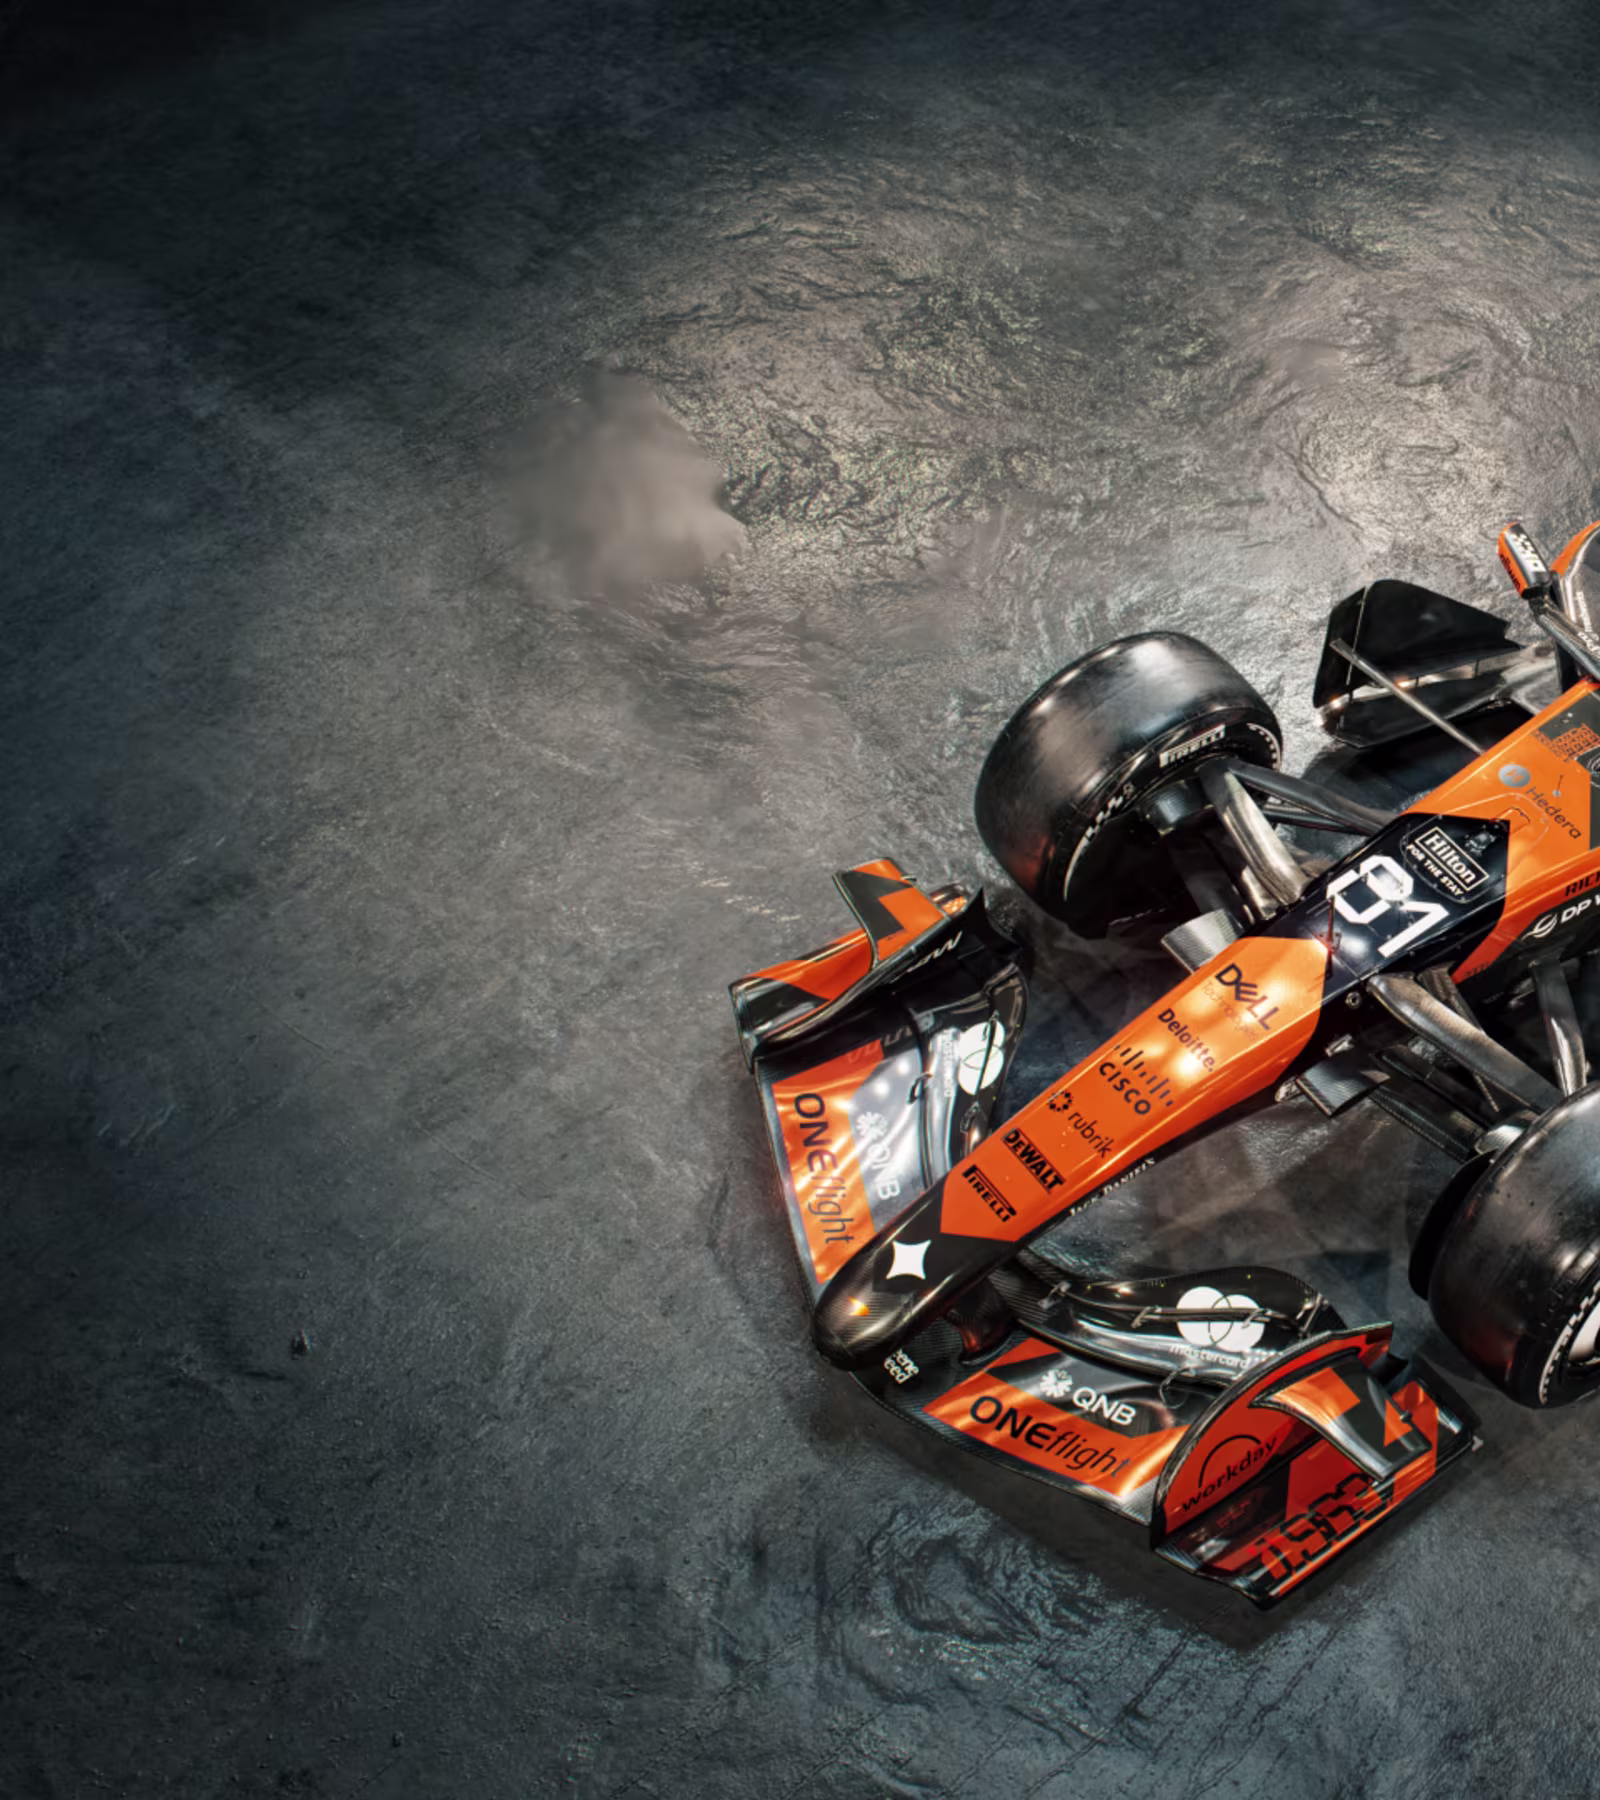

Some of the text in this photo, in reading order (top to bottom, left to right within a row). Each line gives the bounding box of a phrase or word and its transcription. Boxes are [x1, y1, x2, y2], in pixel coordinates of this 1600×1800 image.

[1159, 724, 1226, 768] PIRELLI
[1525, 786, 1581, 840] Hedera
[1405, 844, 1464, 897] FOR THE STAY
[1424, 833, 1476, 885] Hilton
[1326, 854, 1450, 958] 81
[1560, 898, 1593, 925] DP
[1216, 963, 1279, 1031] DELL
[1158, 1008, 1216, 1073] Deloitte.
[1001, 1128, 1066, 1194] DEWALT
[1066, 1110, 1118, 1160] rubrik
[794, 1092, 857, 1246] ONEflight
[863, 1142, 901, 1201] QNB
[961, 1164, 1017, 1223] PIRELLI
[1168, 1345, 1250, 1370] mastercard
[1072, 1386, 1137, 1428] QNB
[968, 1395, 1132, 1479] ONEflight
[1181, 1436, 1278, 1512] workday
